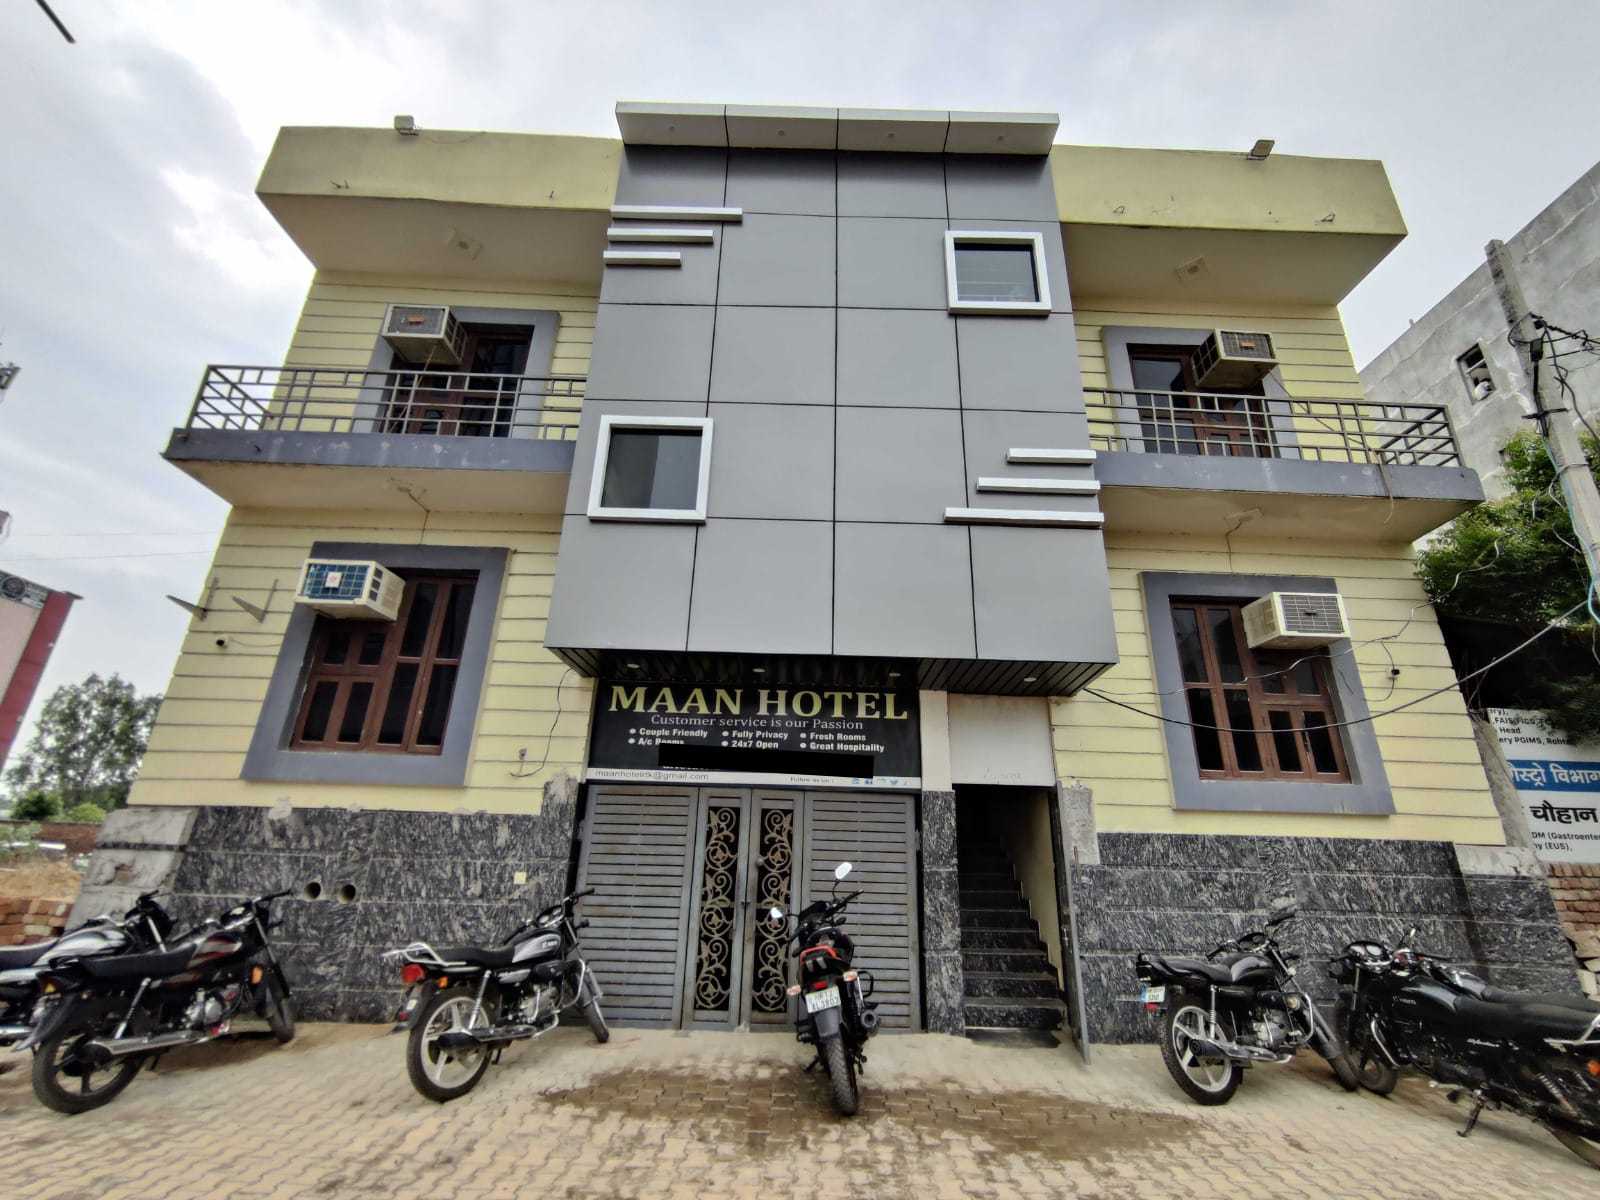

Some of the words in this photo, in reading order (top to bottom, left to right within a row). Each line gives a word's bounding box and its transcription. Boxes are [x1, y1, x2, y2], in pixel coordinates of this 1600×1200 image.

[608, 685, 743, 715] MAAN
[756, 689, 908, 720] HOTEL
[651, 714, 716, 726] Customer
[719, 716, 767, 728] service
[771, 718, 782, 727] is
[785, 719, 809, 729] our
[812, 719, 864, 730] Passion
[639, 728, 670, 737] Couple
[672, 729, 708, 738] Friendly
[731, 730, 754, 740] Fully
[755, 731, 788, 741] Privacy
[809, 732, 835, 741] Fresh
[836, 733, 867, 742] Rooms
[731, 740, 753, 749] 24x7
[755, 741, 779, 750] Open
[809, 742, 835, 751] Great
[836, 743, 885, 753] Hospitality
[1529, 800, 1599, 824] चौहान
